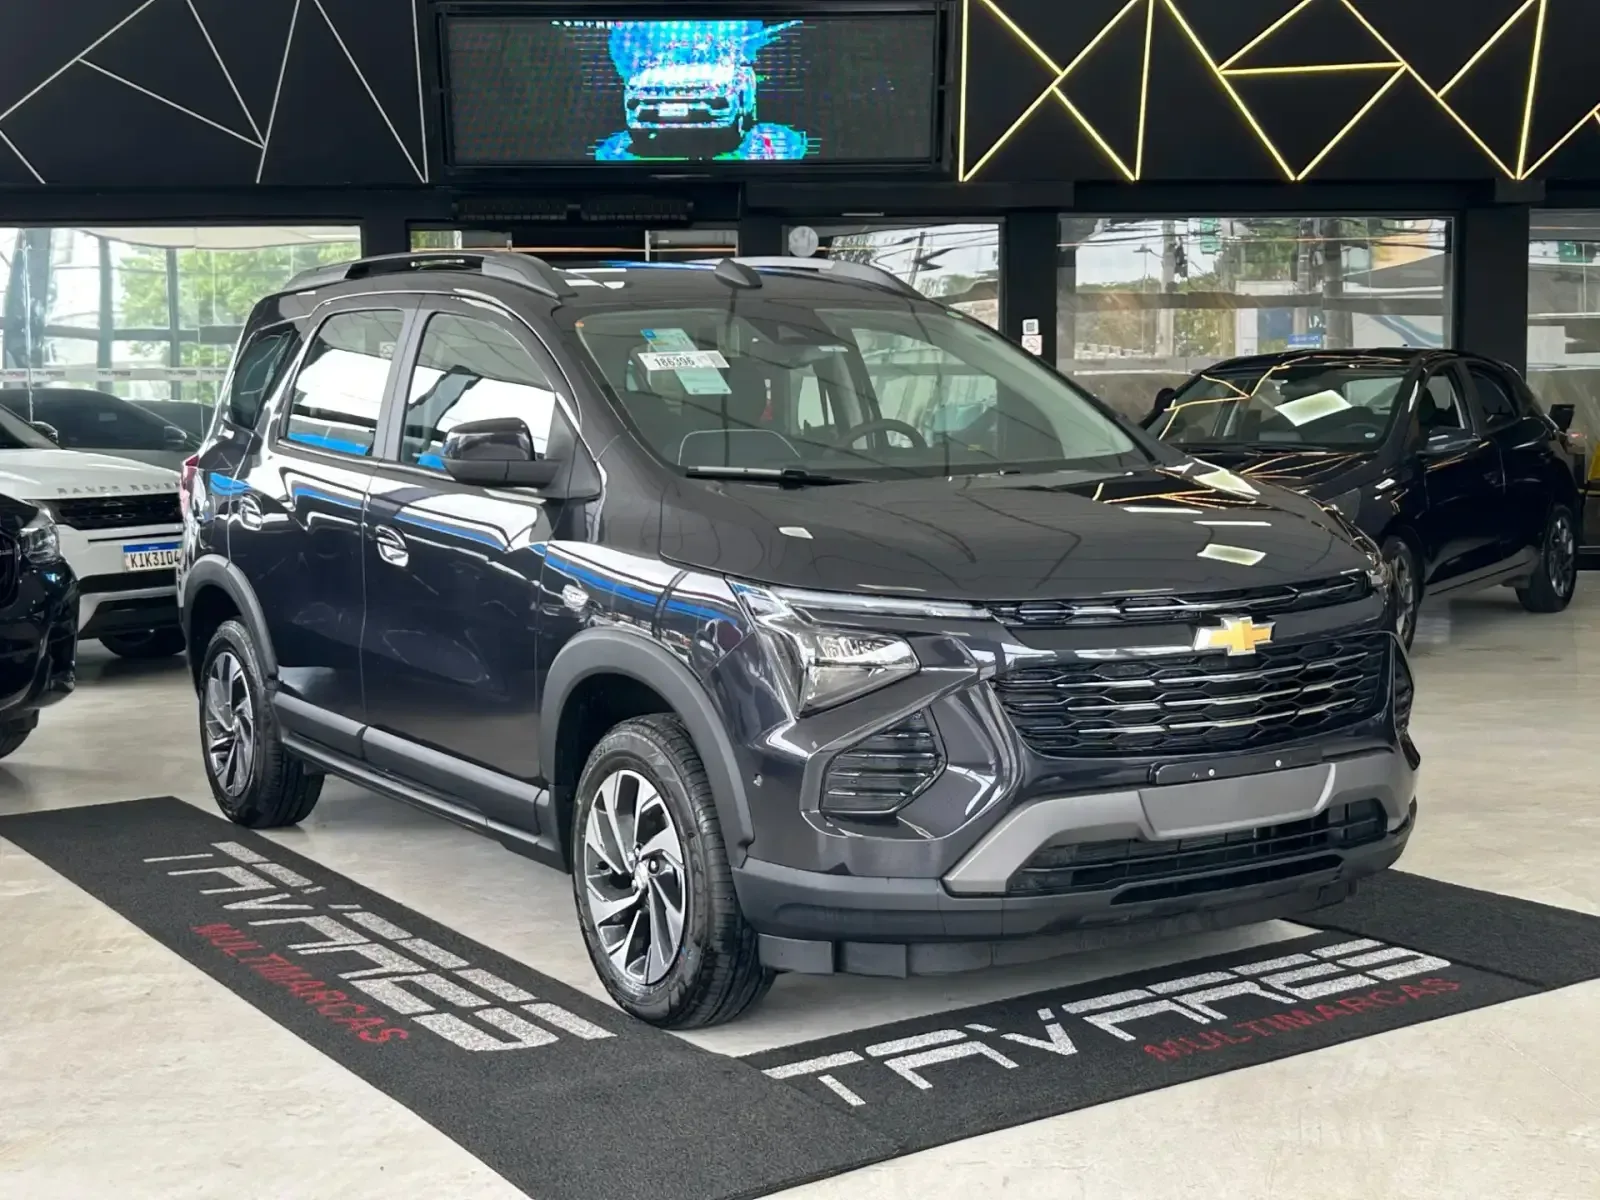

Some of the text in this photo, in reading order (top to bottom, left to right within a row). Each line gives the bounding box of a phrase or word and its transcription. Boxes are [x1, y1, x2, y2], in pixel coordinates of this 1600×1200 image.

[143, 841, 618, 1052] TAVARES
[191, 922, 409, 1044] MULTIMARCAS
[764, 938, 1452, 1107] TAVARES
[1142, 976, 1462, 1063] MULTIMARCAS
